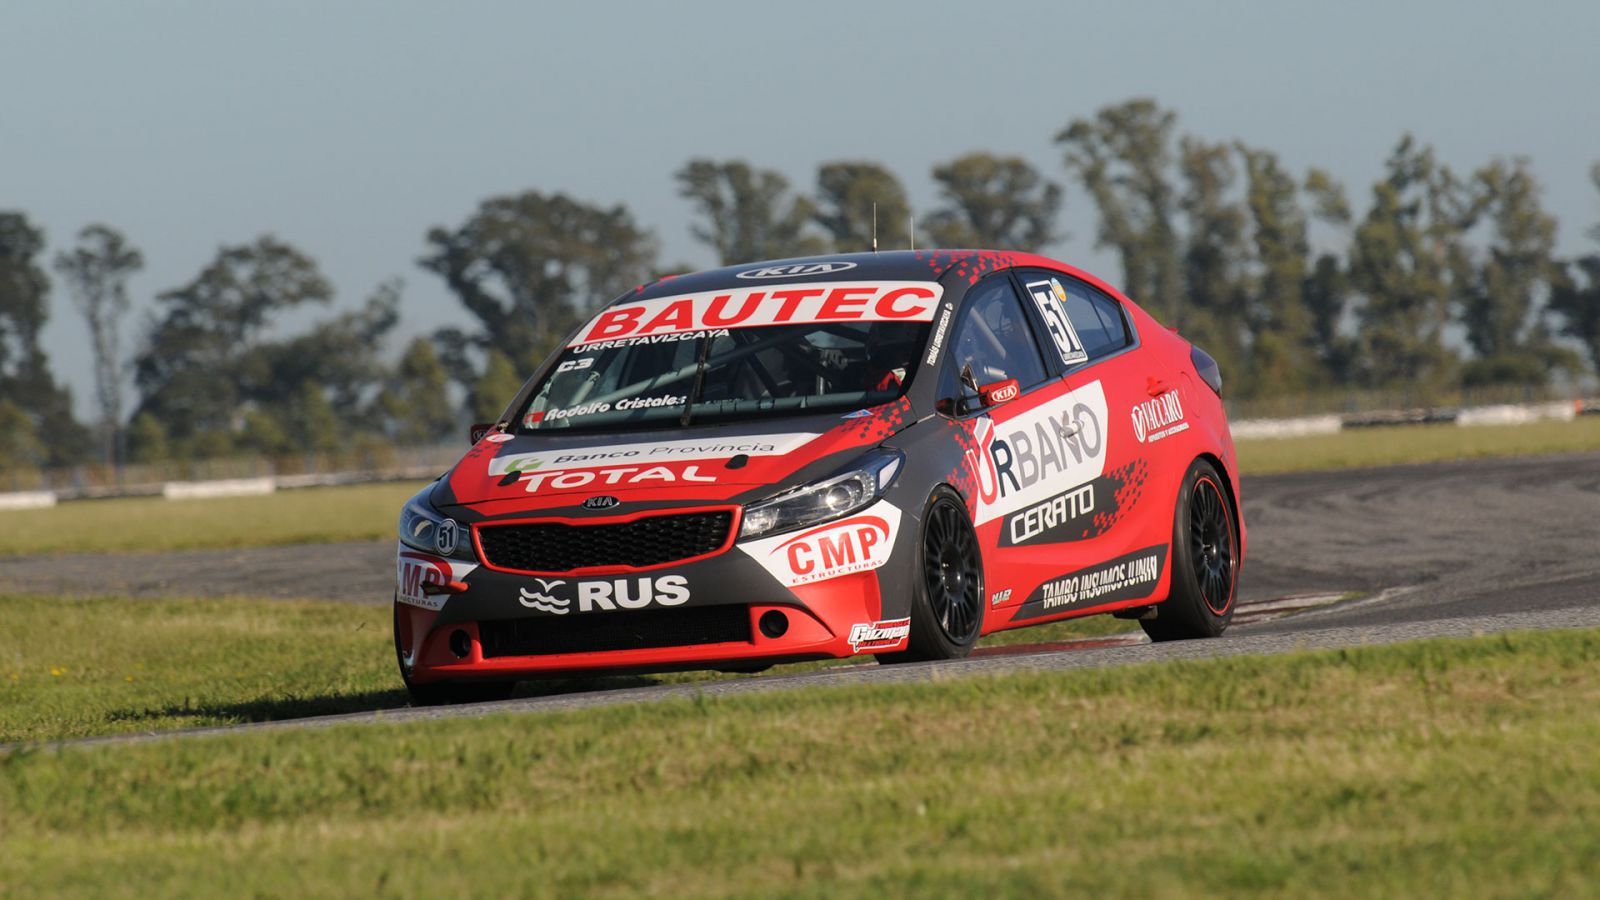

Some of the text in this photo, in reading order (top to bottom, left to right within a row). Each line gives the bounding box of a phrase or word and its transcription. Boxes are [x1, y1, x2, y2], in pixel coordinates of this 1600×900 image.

[754, 264, 833, 277] KIA
[584, 287, 935, 342] BAUTEC
[1034, 290, 1081, 352] 51
[573, 329, 730, 354] URRETAVIZCAYA
[996, 385, 1015, 399] KIA
[544, 402, 610, 421] Rodolfo
[615, 395, 687, 410] Cristales
[1141, 389, 1184, 432] VACCARO
[553, 442, 775, 464] Banco Provincia
[966, 403, 1101, 505] URBANO
[519, 466, 717, 492] TOTAL
[586, 496, 613, 507] KIA
[1010, 484, 1094, 544] CERATO
[440, 526, 454, 549] 51
[787, 527, 878, 575] CMP
[400, 561, 441, 600] MP
[792, 560, 883, 583] ESTRUCTURAS
[1042, 577, 1079, 609] TAMBO
[1080, 564, 1126, 600] INSUMOS
[578, 575, 690, 612] RUS
